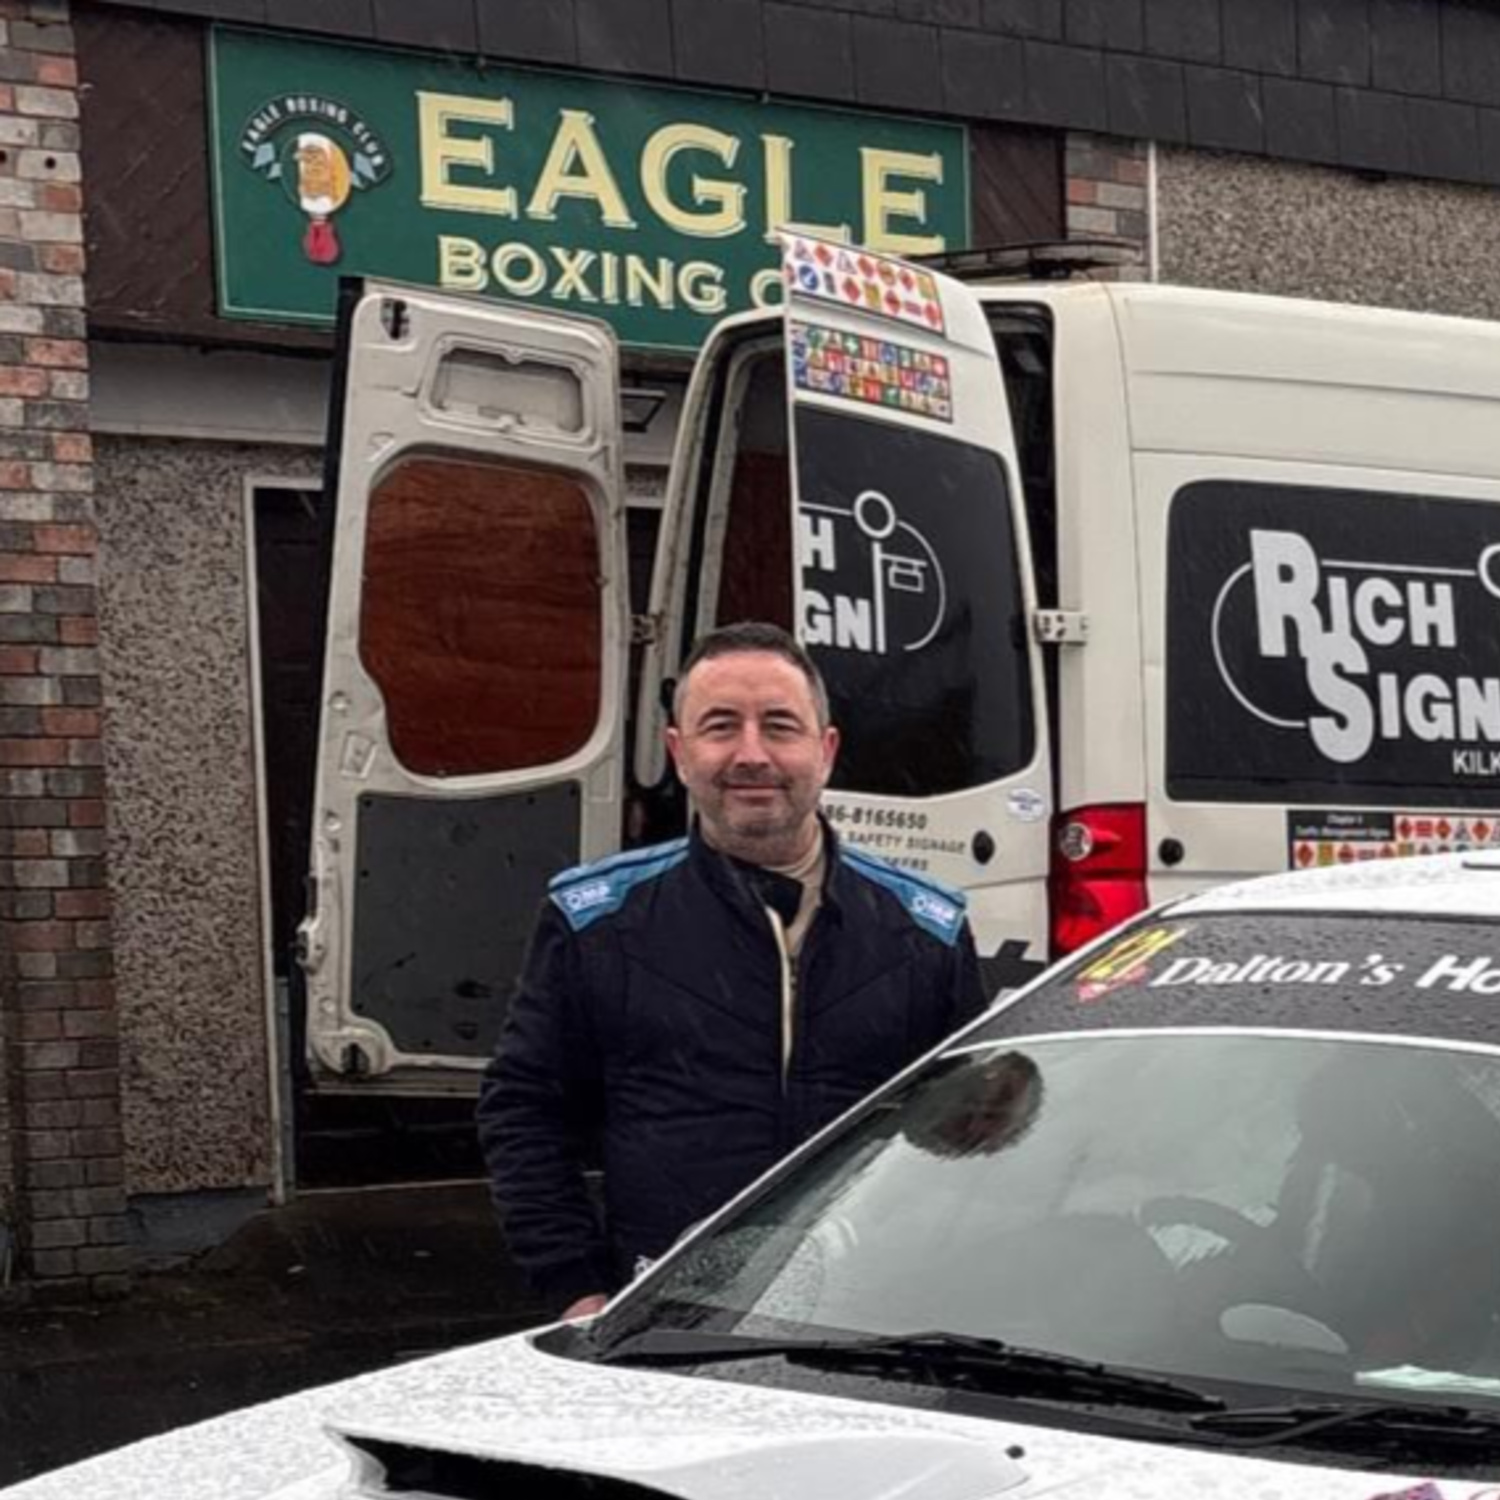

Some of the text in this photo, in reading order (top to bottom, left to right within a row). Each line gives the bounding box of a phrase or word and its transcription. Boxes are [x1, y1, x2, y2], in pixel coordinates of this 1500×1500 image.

[415, 90, 945, 257] EAGLE
[438, 234, 728, 315] BOXING
[1250, 529, 1457, 659] RICH
[1149, 952, 1405, 987] Dalton's
